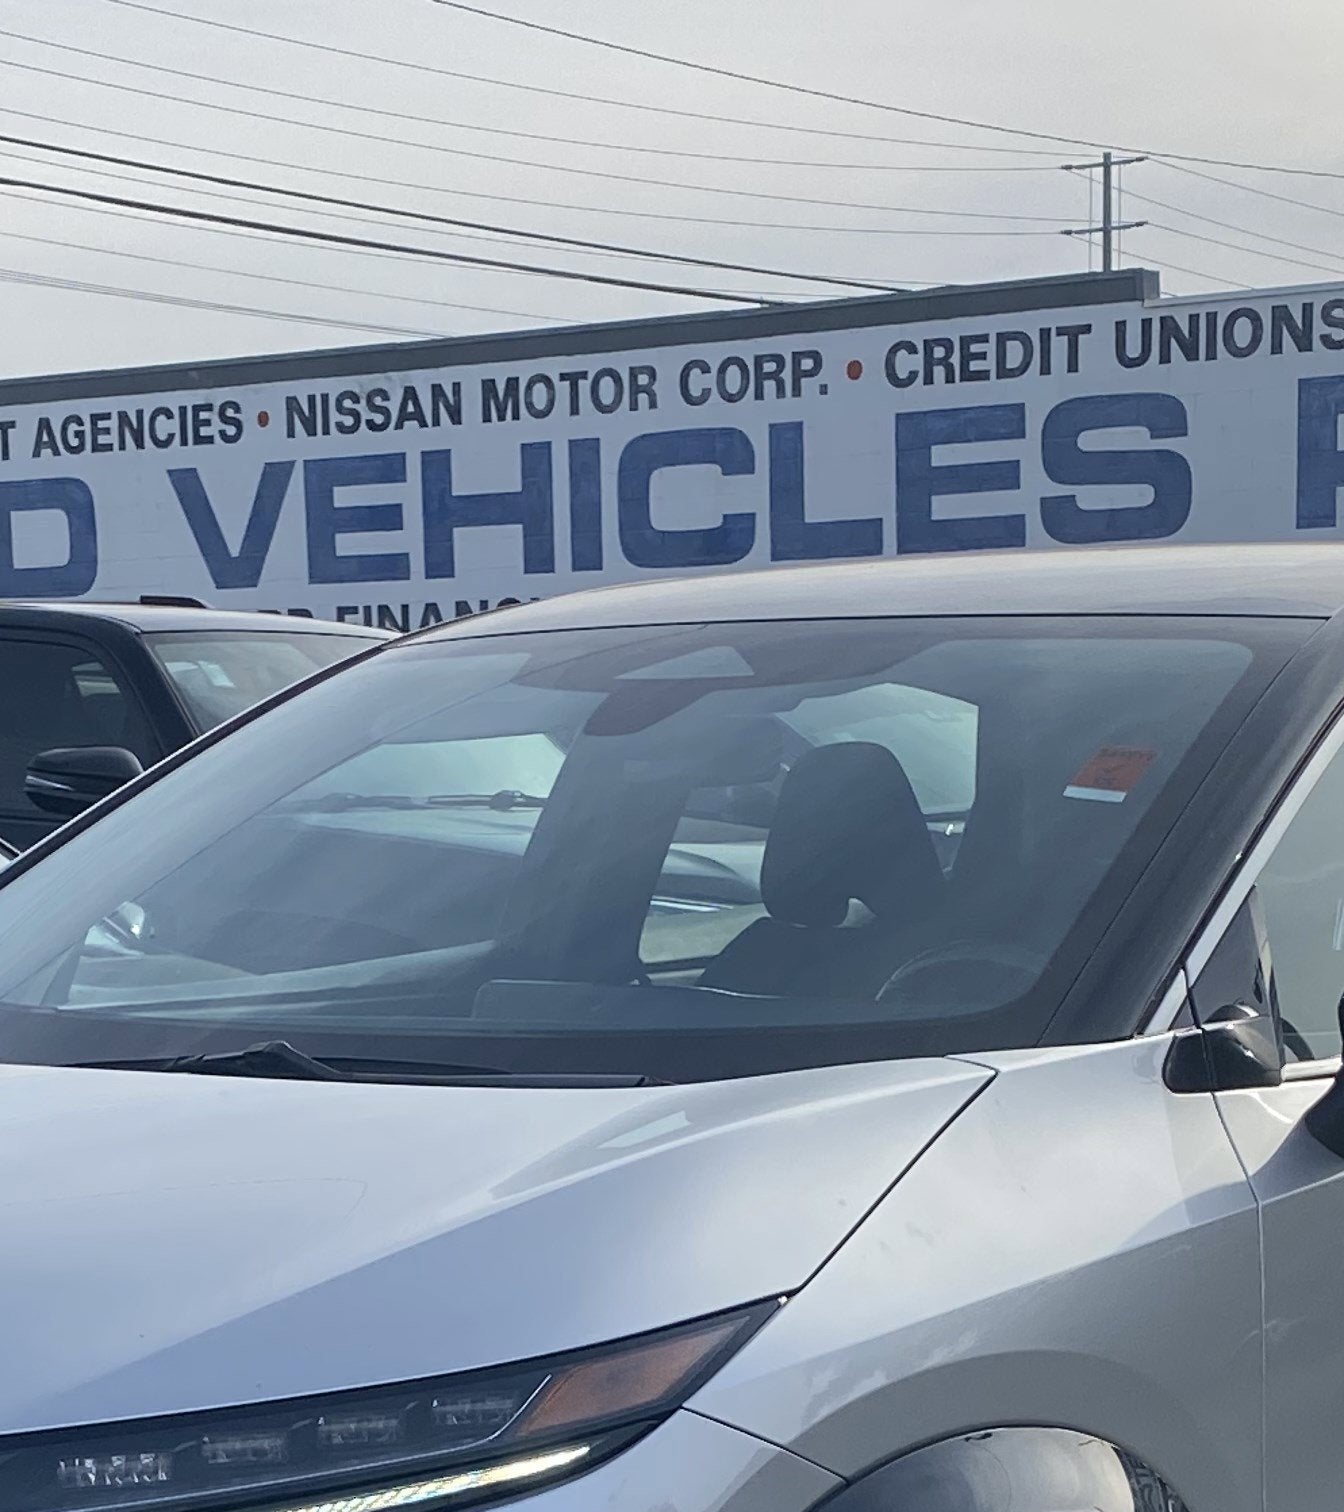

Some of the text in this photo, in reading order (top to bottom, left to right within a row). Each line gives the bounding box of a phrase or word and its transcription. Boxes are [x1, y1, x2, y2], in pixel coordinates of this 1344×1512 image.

[31, 400, 243, 459] AGENCIES
[286, 381, 462, 439] NISSAN
[480, 365, 658, 424] MOTOR
[679, 349, 829, 406] CORP.
[884, 324, 1092, 389] CREDIT
[167, 391, 1193, 590] VEHICLES
